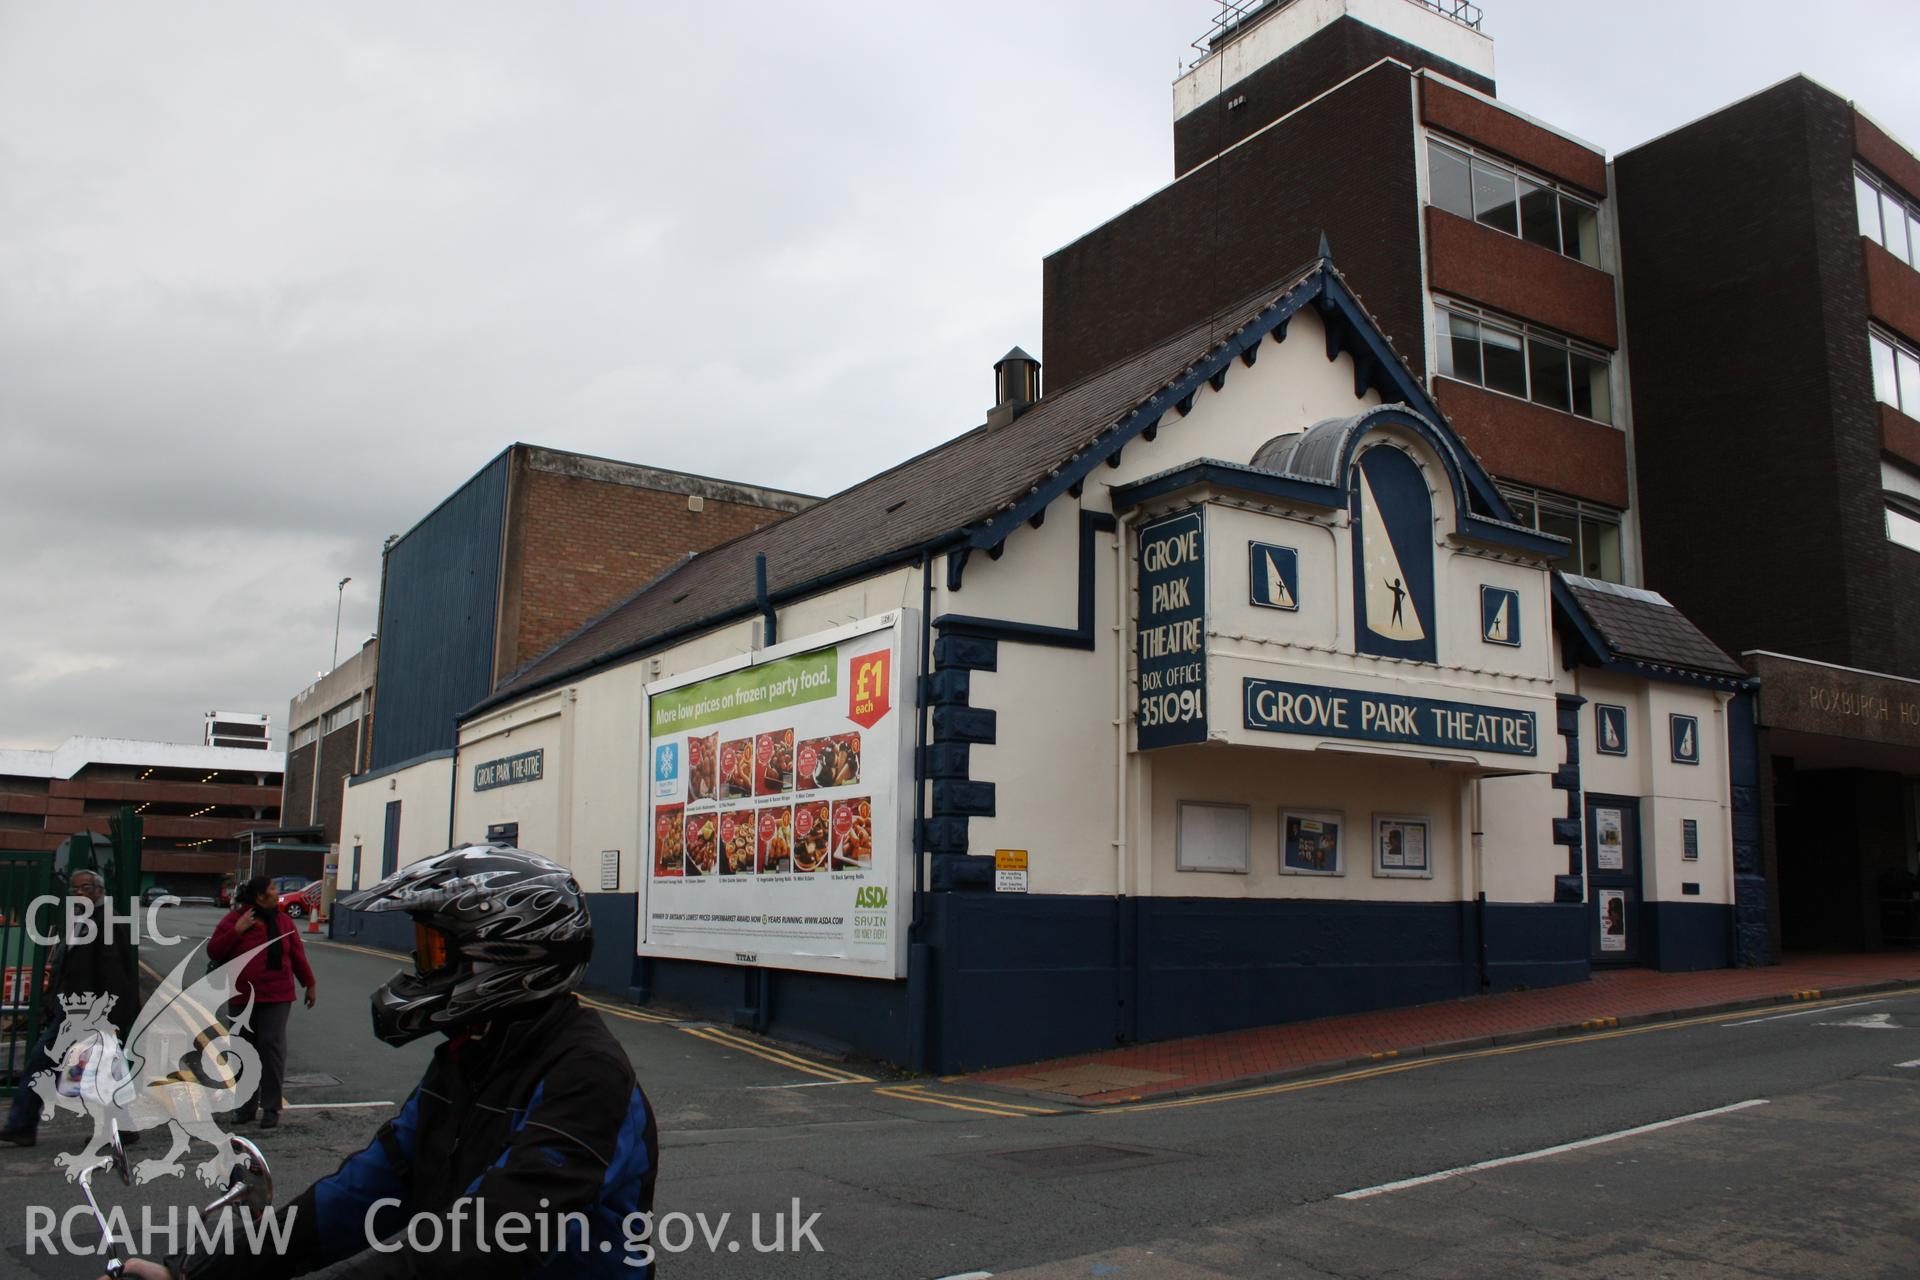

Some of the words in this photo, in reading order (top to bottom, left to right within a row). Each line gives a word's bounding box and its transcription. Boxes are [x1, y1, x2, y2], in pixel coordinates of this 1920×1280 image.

[1144, 530, 1199, 572] GROVE
[1152, 576, 1190, 614] PARK
[1140, 618, 1202, 659] THEATRE
[656, 708, 676, 725] More
[678, 703, 693, 719] low
[694, 696, 720, 720] prices
[722, 694, 734, 707] on
[735, 685, 767, 706] frozen
[769, 676, 798, 702] party
[801, 664, 831, 689] food.
[855, 659, 882, 702] £1
[1143, 671, 1162, 691] BOX
[1167, 663, 1201, 687] OFFICE
[855, 701, 874, 715] each
[1142, 689, 1203, 727] 351091
[1256, 689, 1349, 729] GROVE
[1361, 701, 1420, 736] PARK
[1431, 708, 1530, 747] THEATRE
[1809, 686, 1888, 720] ROXBURGH
[477, 766, 495, 786] GROVE
[496, 763, 511, 782] PARK
[512, 755, 540, 778] THEATRE
[768, 916, 781, 924] YEARS
[804, 916, 843, 925] WWW.ASDA.COM
[854, 916, 887, 927] SAVIN
[735, 953, 757, 962] TITAN
